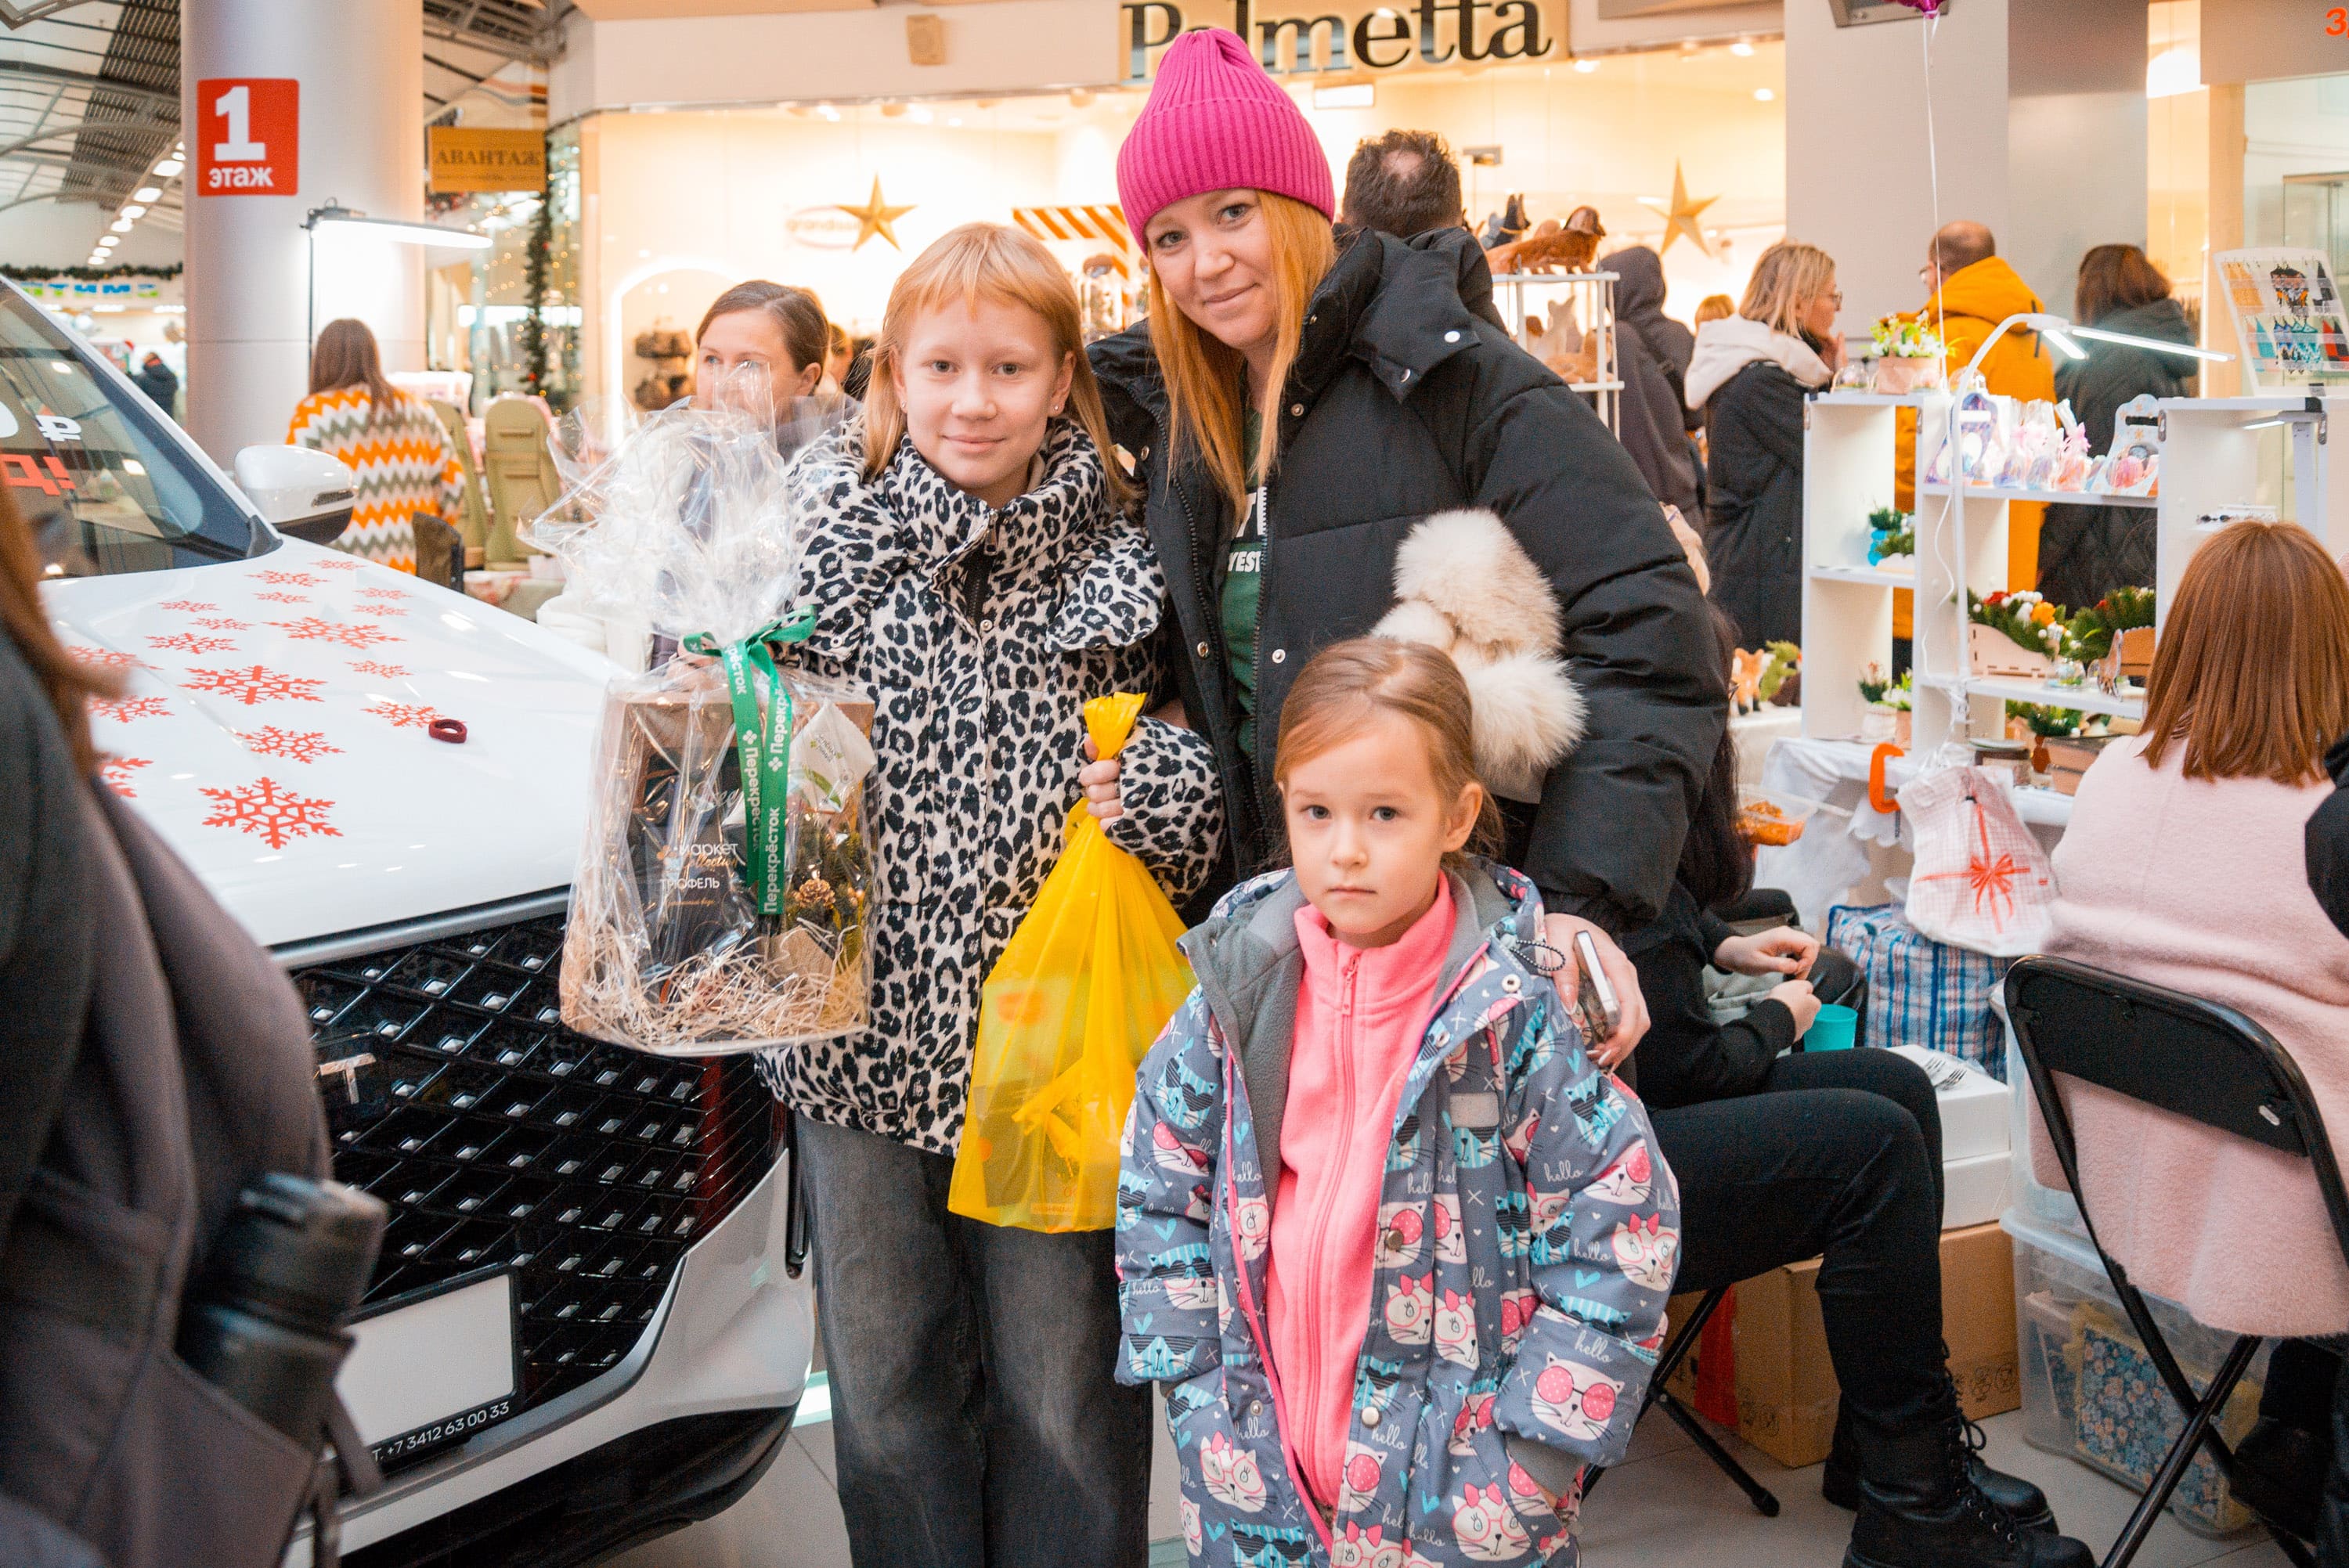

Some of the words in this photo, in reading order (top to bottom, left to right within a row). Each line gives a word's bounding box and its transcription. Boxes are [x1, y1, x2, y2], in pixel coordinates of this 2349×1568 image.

[1122, 0, 1553, 79] Plmetta
[214, 85, 267, 162] 1
[435, 149, 540, 166] АВАНТАЖ
[208, 166, 274, 188] этаж
[725, 643, 747, 695] рёсток
[770, 687, 789, 754] Перекрё
[763, 806, 781, 913] Перекрёсток
[660, 876, 720, 890] ТРЮФЕЛЬ
[1200, 1138, 1218, 1155] llo
[1543, 1159, 1584, 1182] hello
[1132, 1281, 1160, 1296] hello
[1472, 1266, 1495, 1288] llo
[1575, 1329, 1613, 1363] hello
[406, 1426, 442, 1450] 3412
[445, 1417, 464, 1436] 63
[467, 1409, 487, 1427] 00
[489, 1400, 510, 1418] 33
[1234, 1417, 1269, 1440] hello
[1371, 1423, 1407, 1451] hello
[1181, 1465, 1197, 1488] llo
[1409, 1519, 1445, 1548] hello
